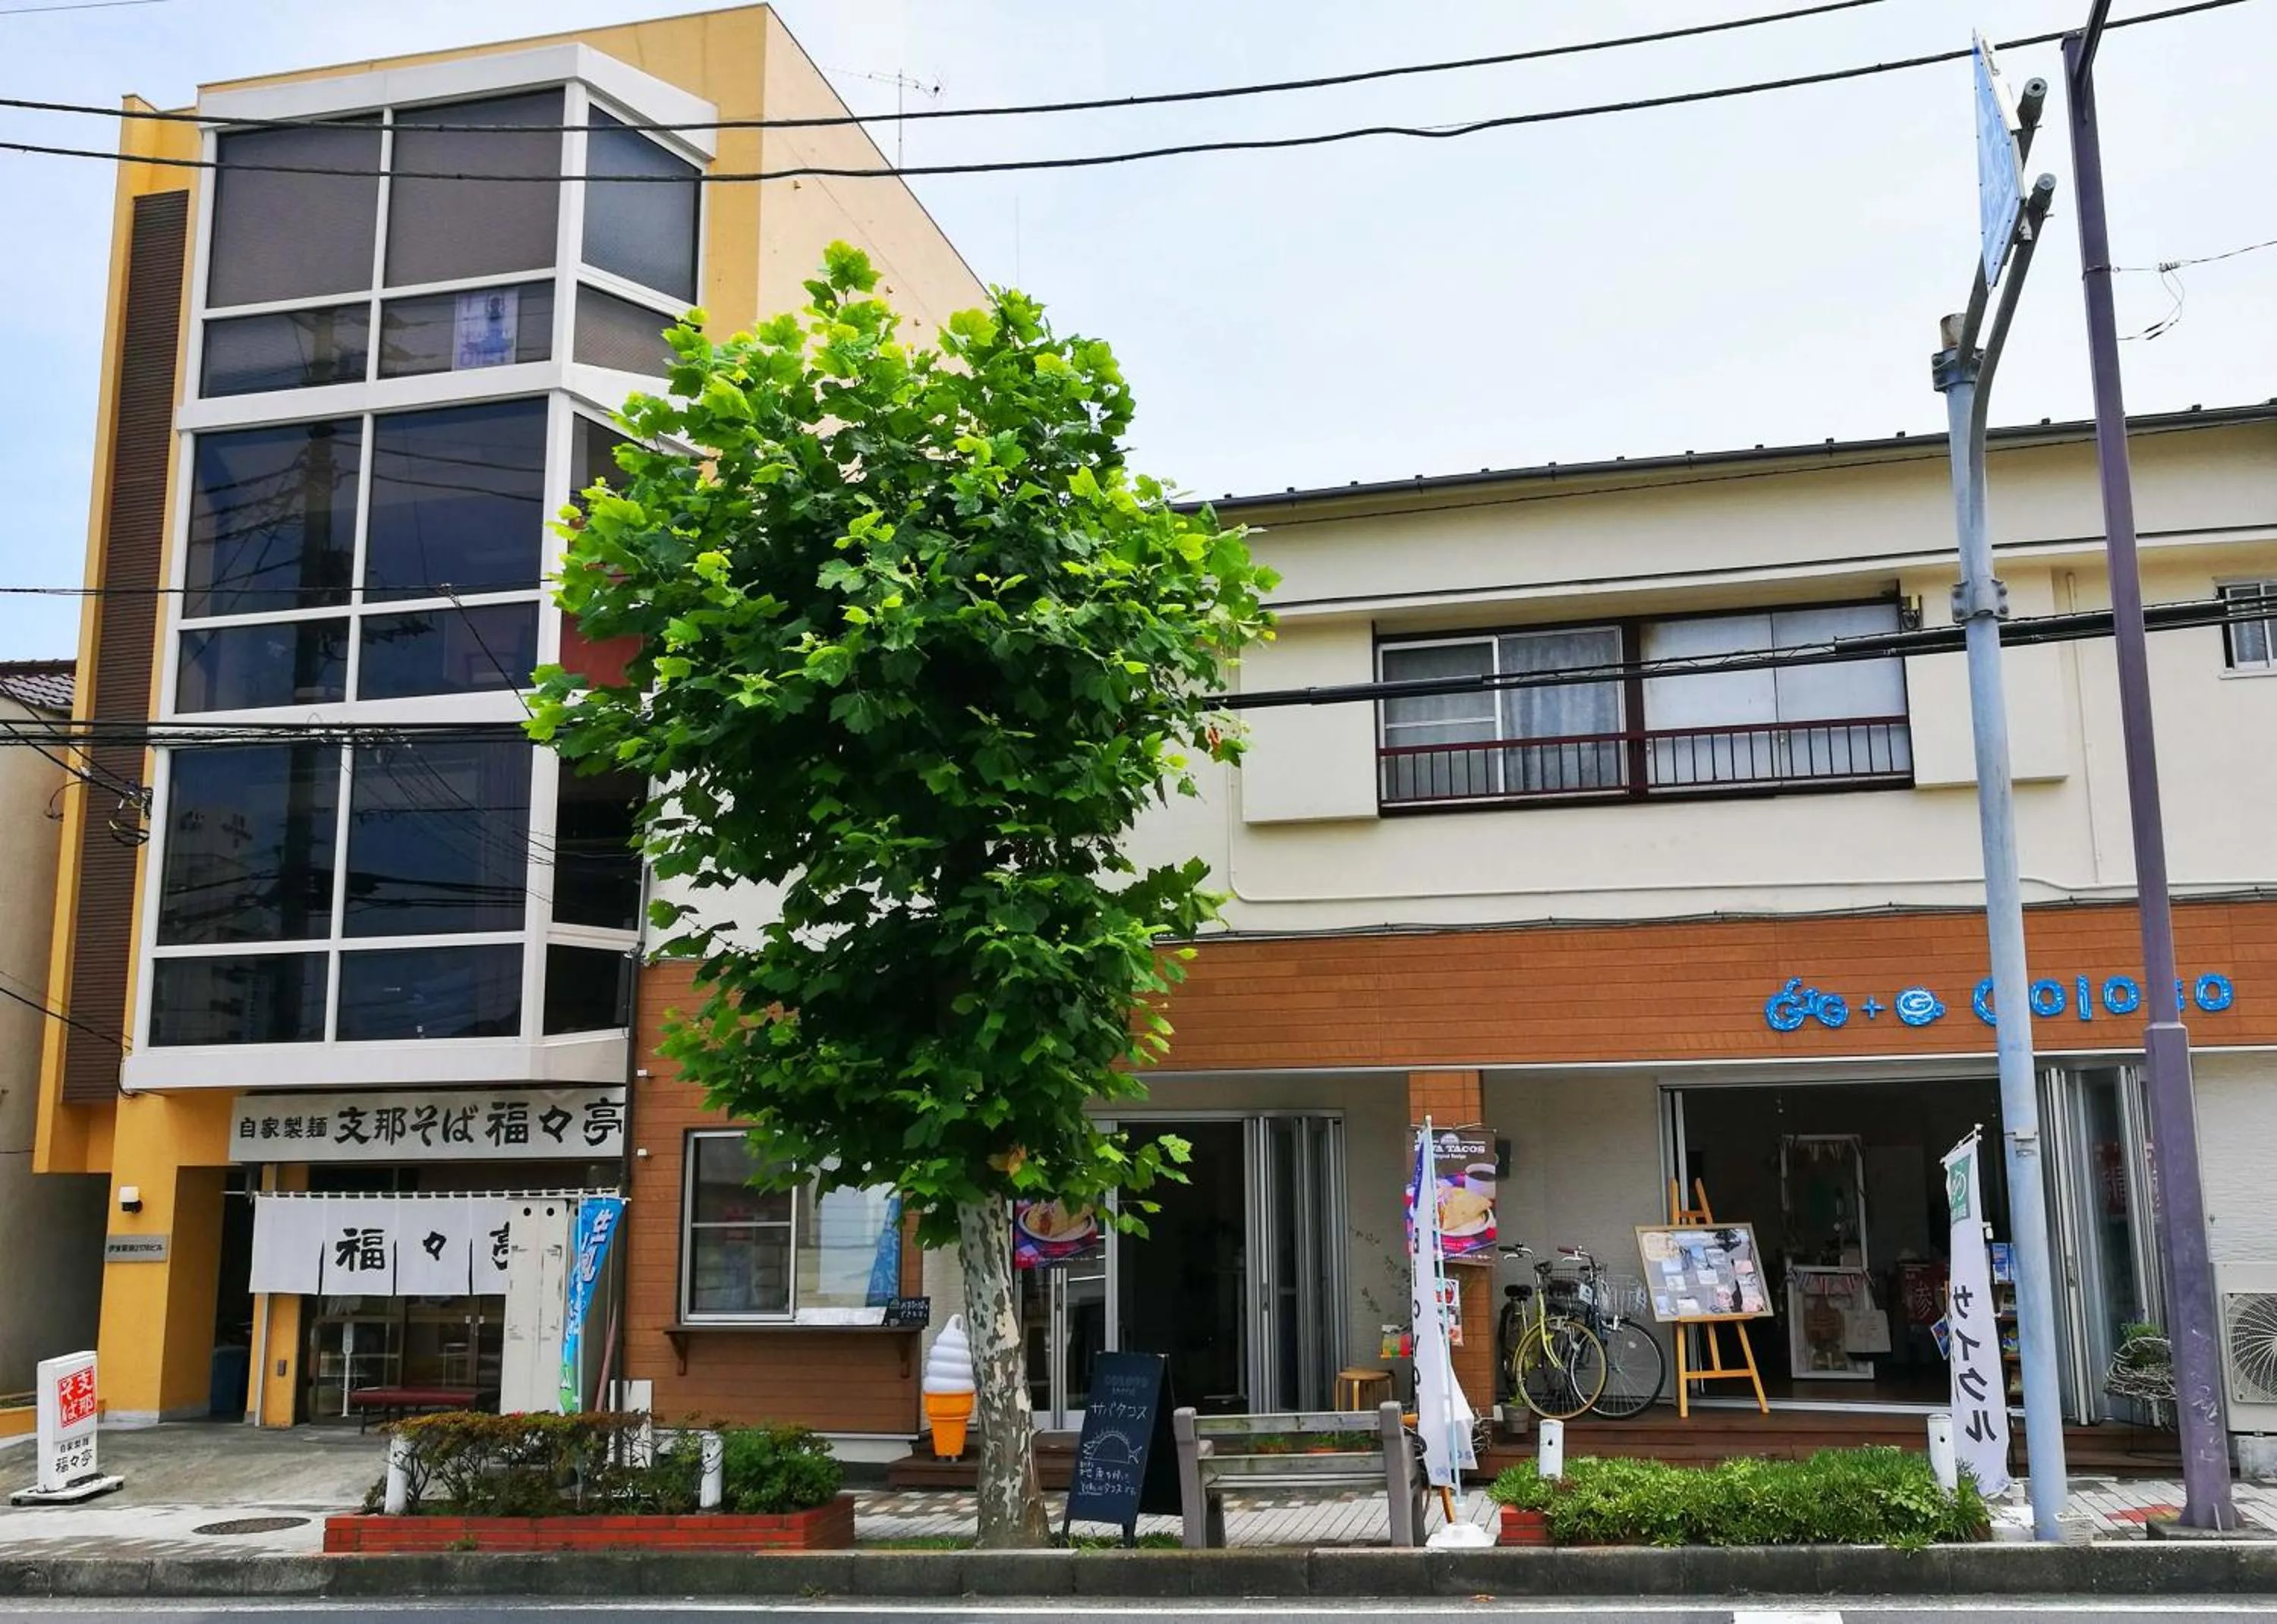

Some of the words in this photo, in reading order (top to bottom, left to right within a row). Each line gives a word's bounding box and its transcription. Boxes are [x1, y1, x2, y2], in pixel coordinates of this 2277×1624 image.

[240, 1116, 329, 1140] 自家製麺
[333, 1104, 480, 1147] 支那そば
[485, 1097, 626, 1147] 福々亭
[1446, 1144, 1486, 1153] TACOS
[55, 1449, 93, 1474] 福々亭
